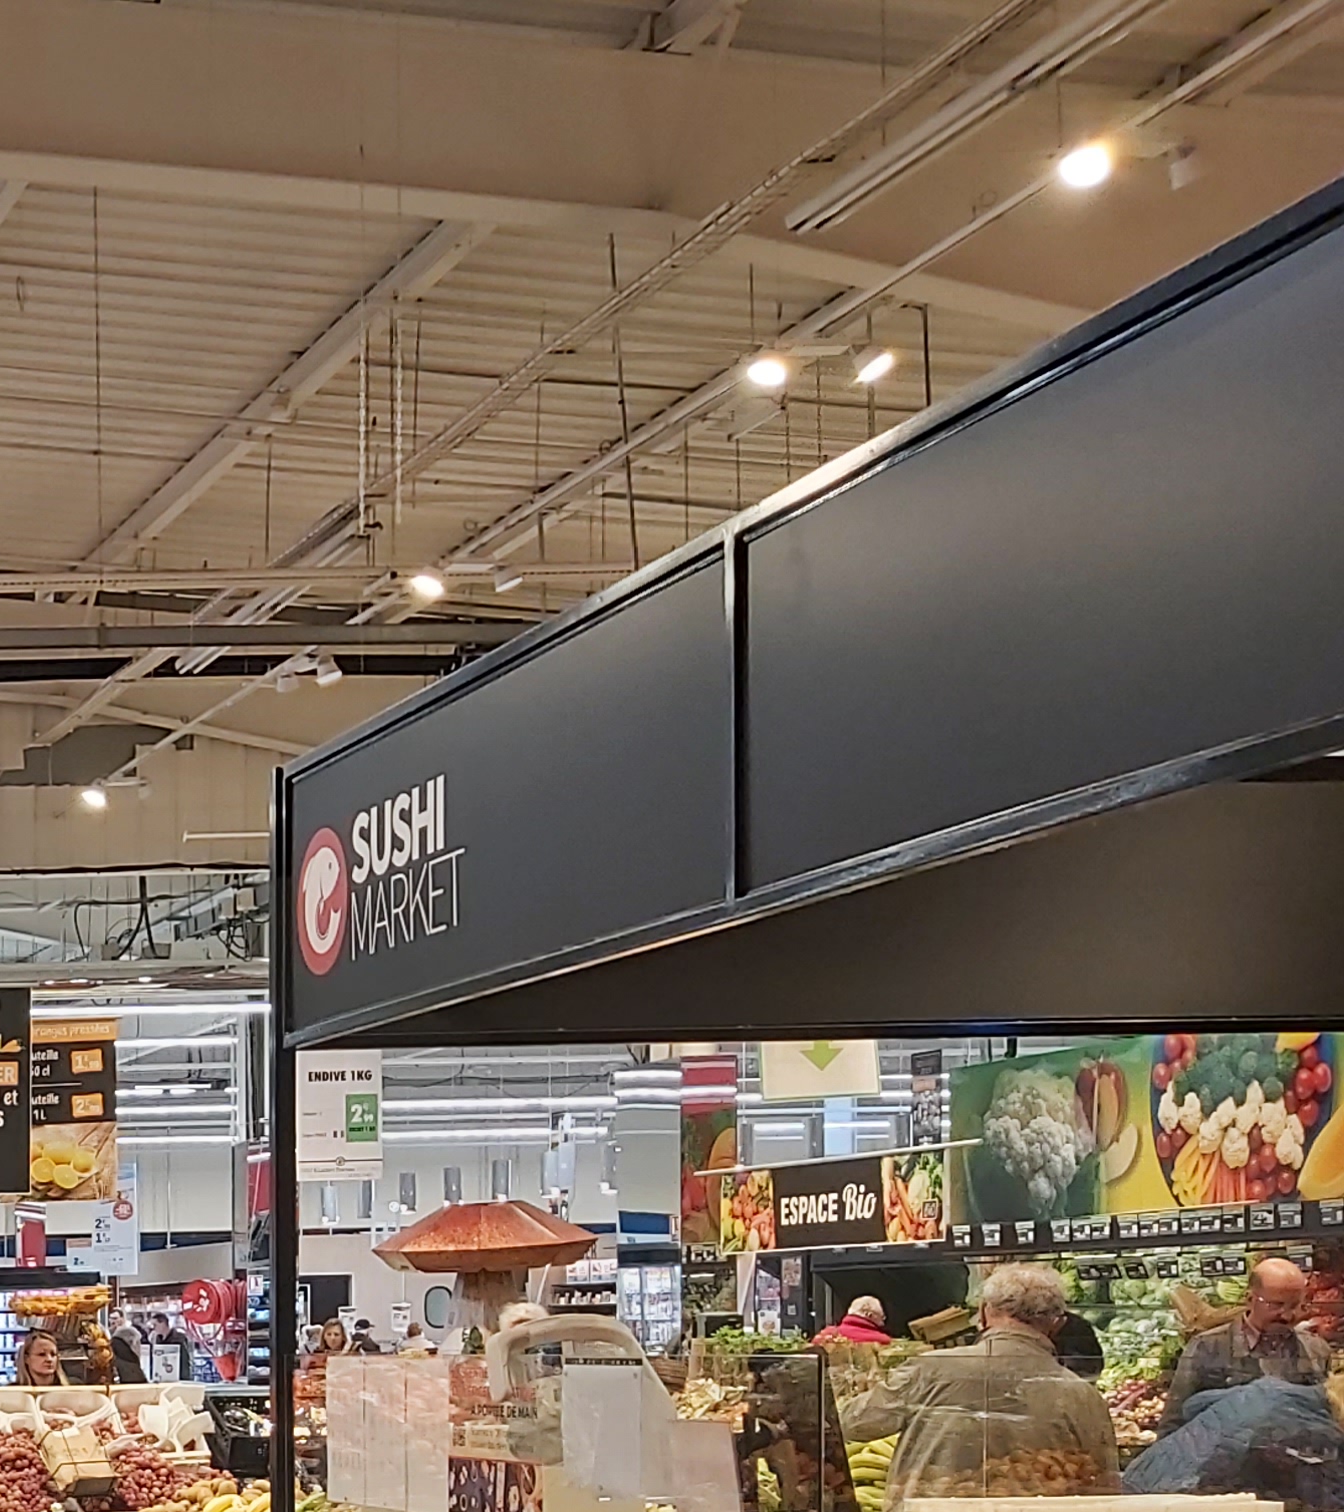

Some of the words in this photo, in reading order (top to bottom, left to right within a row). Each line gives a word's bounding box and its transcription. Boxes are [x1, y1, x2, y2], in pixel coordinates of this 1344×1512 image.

[351, 773, 446, 884] SUSHI
[351, 847, 466, 961] MARKET
[308, 1070, 347, 1082] ENDIVE
[351, 1069, 373, 1081] 1KG
[3, 1091, 19, 1107] et
[779, 1189, 839, 1227] ESPACE
[842, 1181, 876, 1220] Bio
